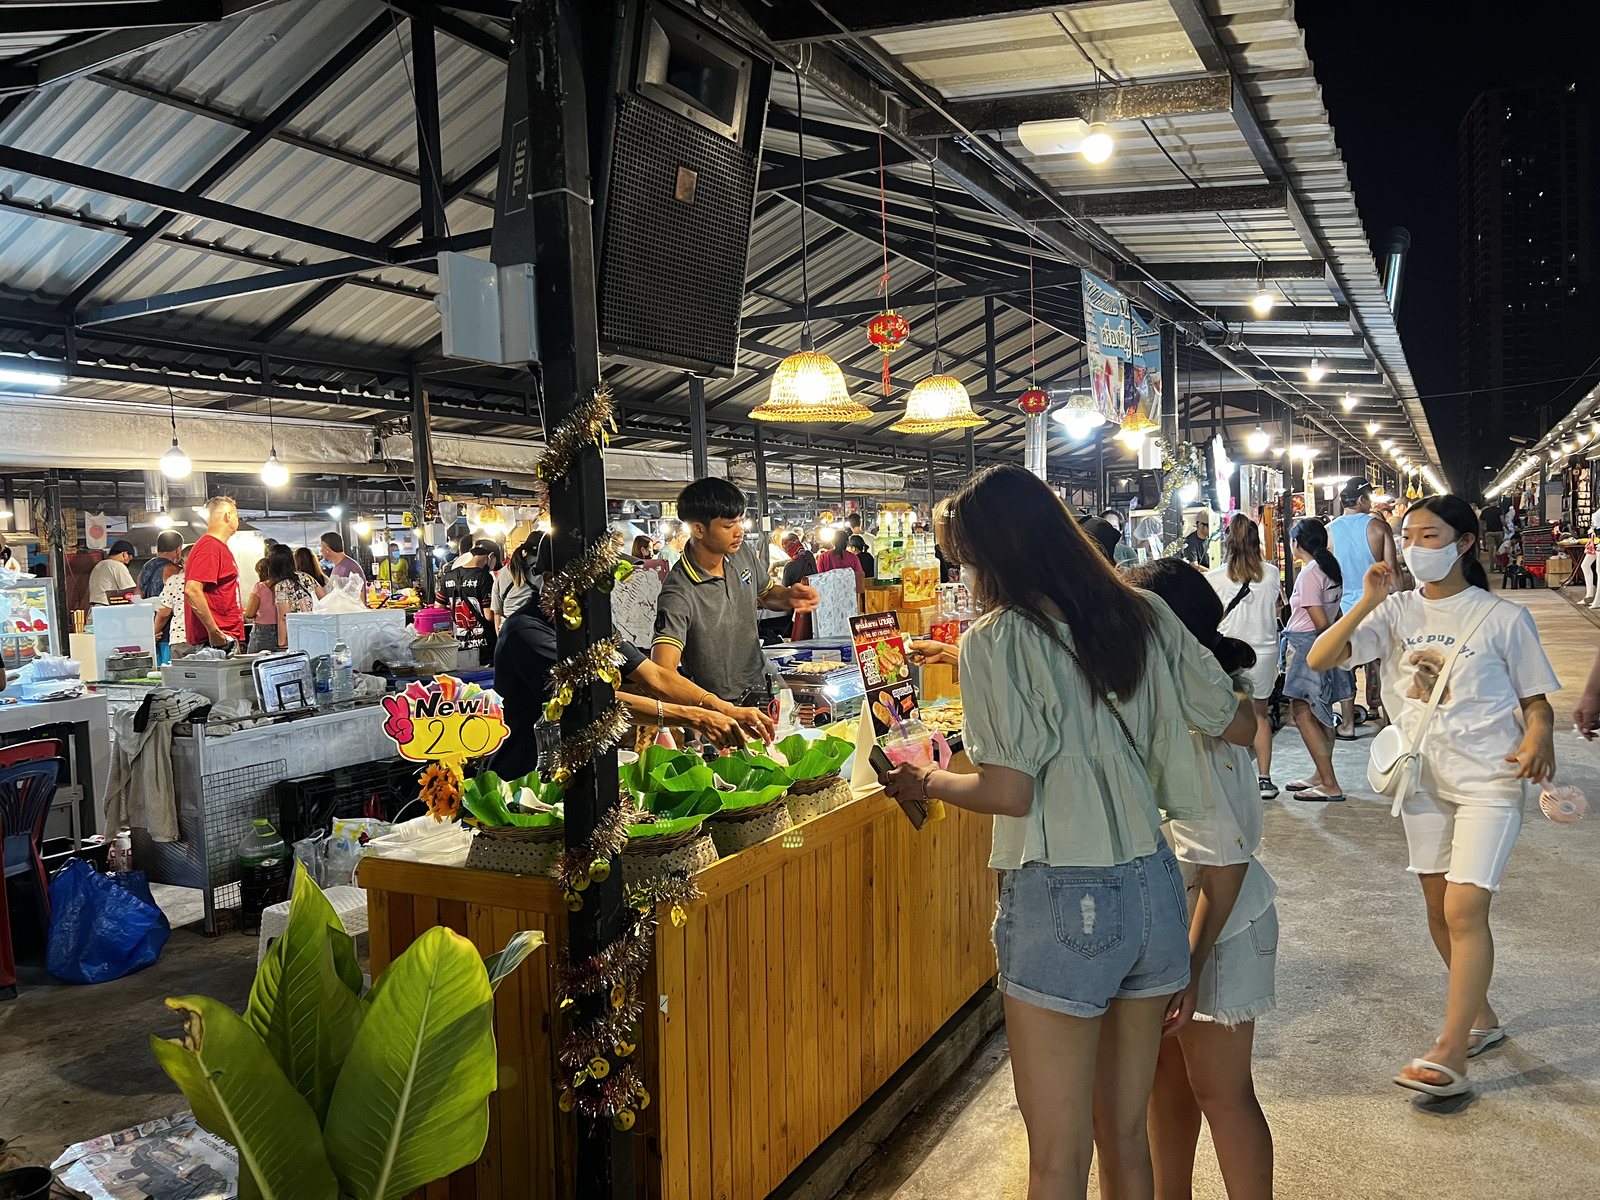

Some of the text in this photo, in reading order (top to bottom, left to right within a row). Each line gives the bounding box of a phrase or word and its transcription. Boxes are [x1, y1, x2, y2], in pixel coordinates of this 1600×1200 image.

[512, 138, 527, 197] JBL
[1426, 634, 1475, 658] pupy!
[415, 691, 491, 719] New!
[424, 715, 490, 755] 20
